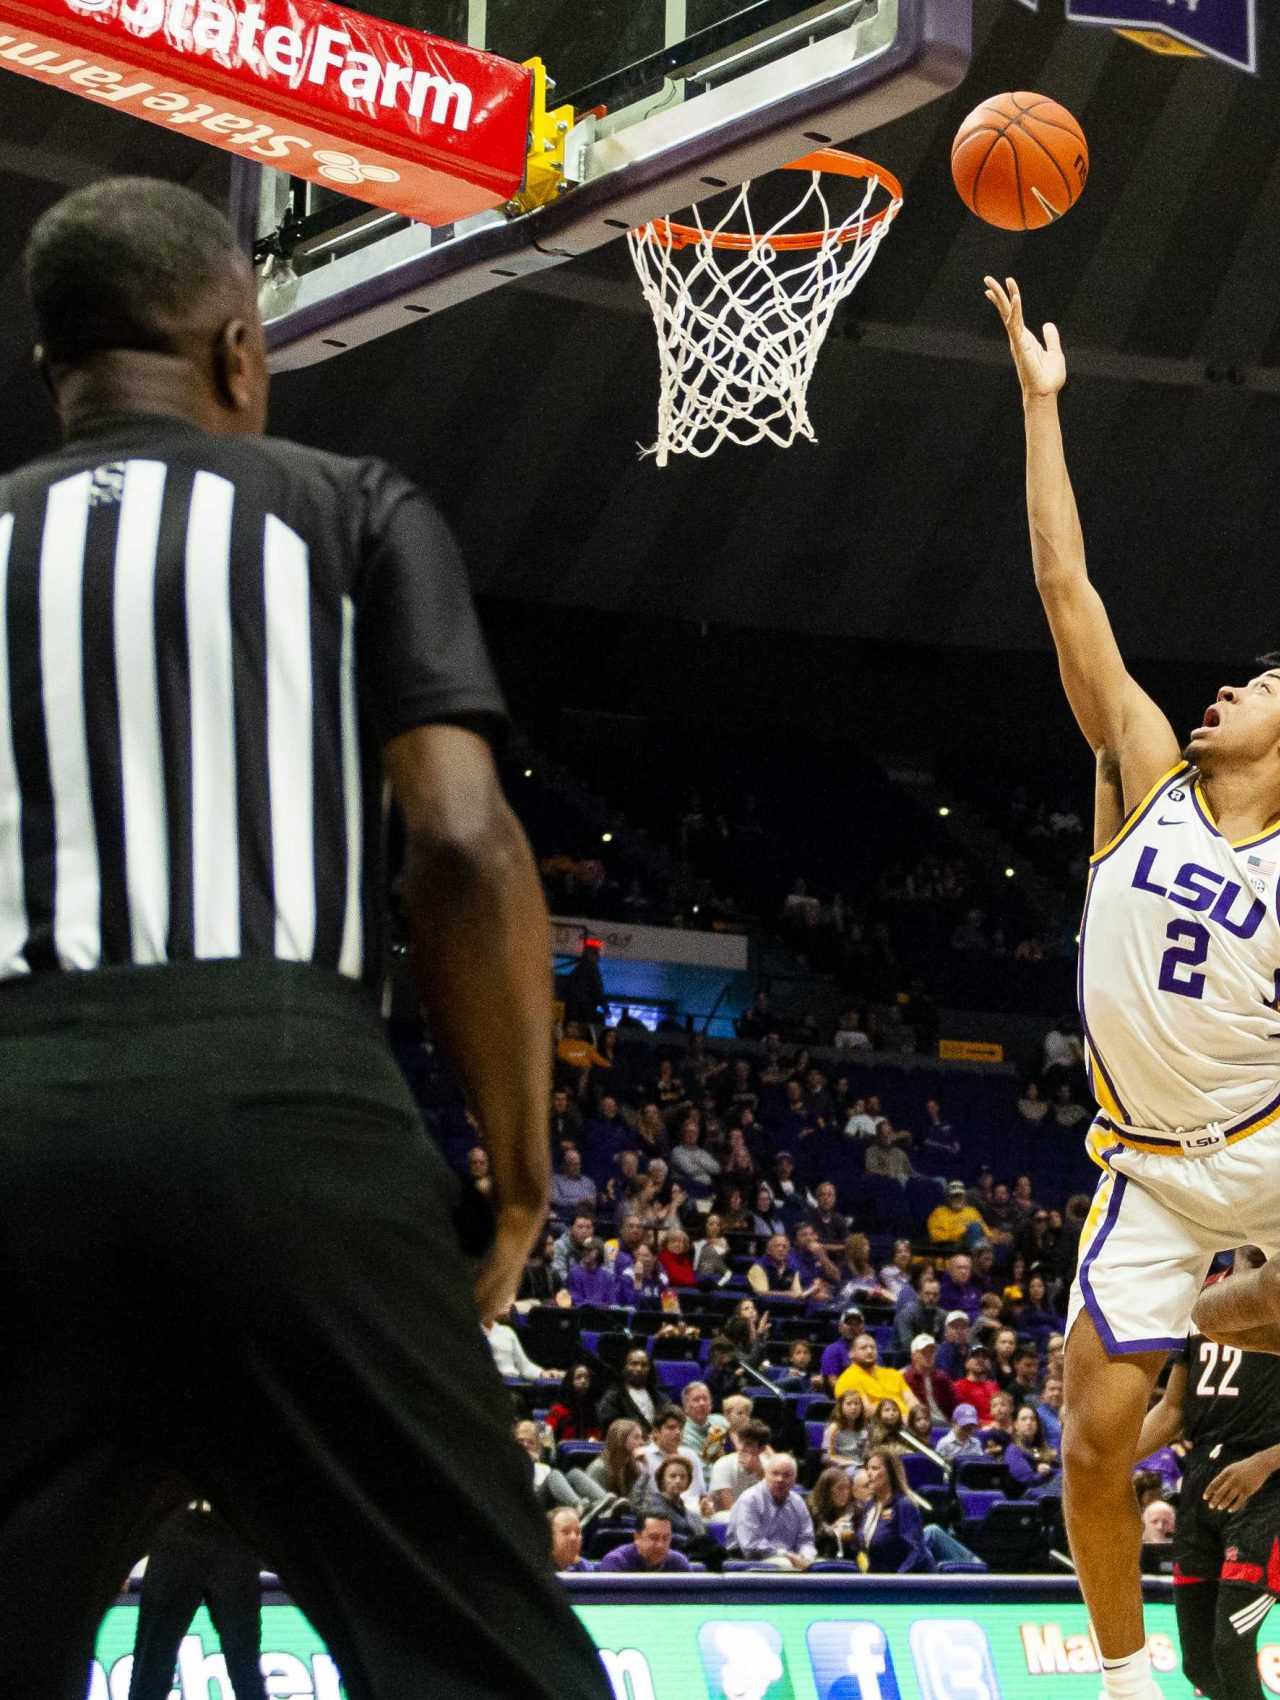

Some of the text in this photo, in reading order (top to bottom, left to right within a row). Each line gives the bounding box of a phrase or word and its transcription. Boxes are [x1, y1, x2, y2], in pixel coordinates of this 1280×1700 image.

[1131, 845, 1267, 939] LSU
[1158, 918, 1211, 999] 2
[1186, 1136, 1220, 1148] LSU
[1196, 1342, 1242, 1396] 22
